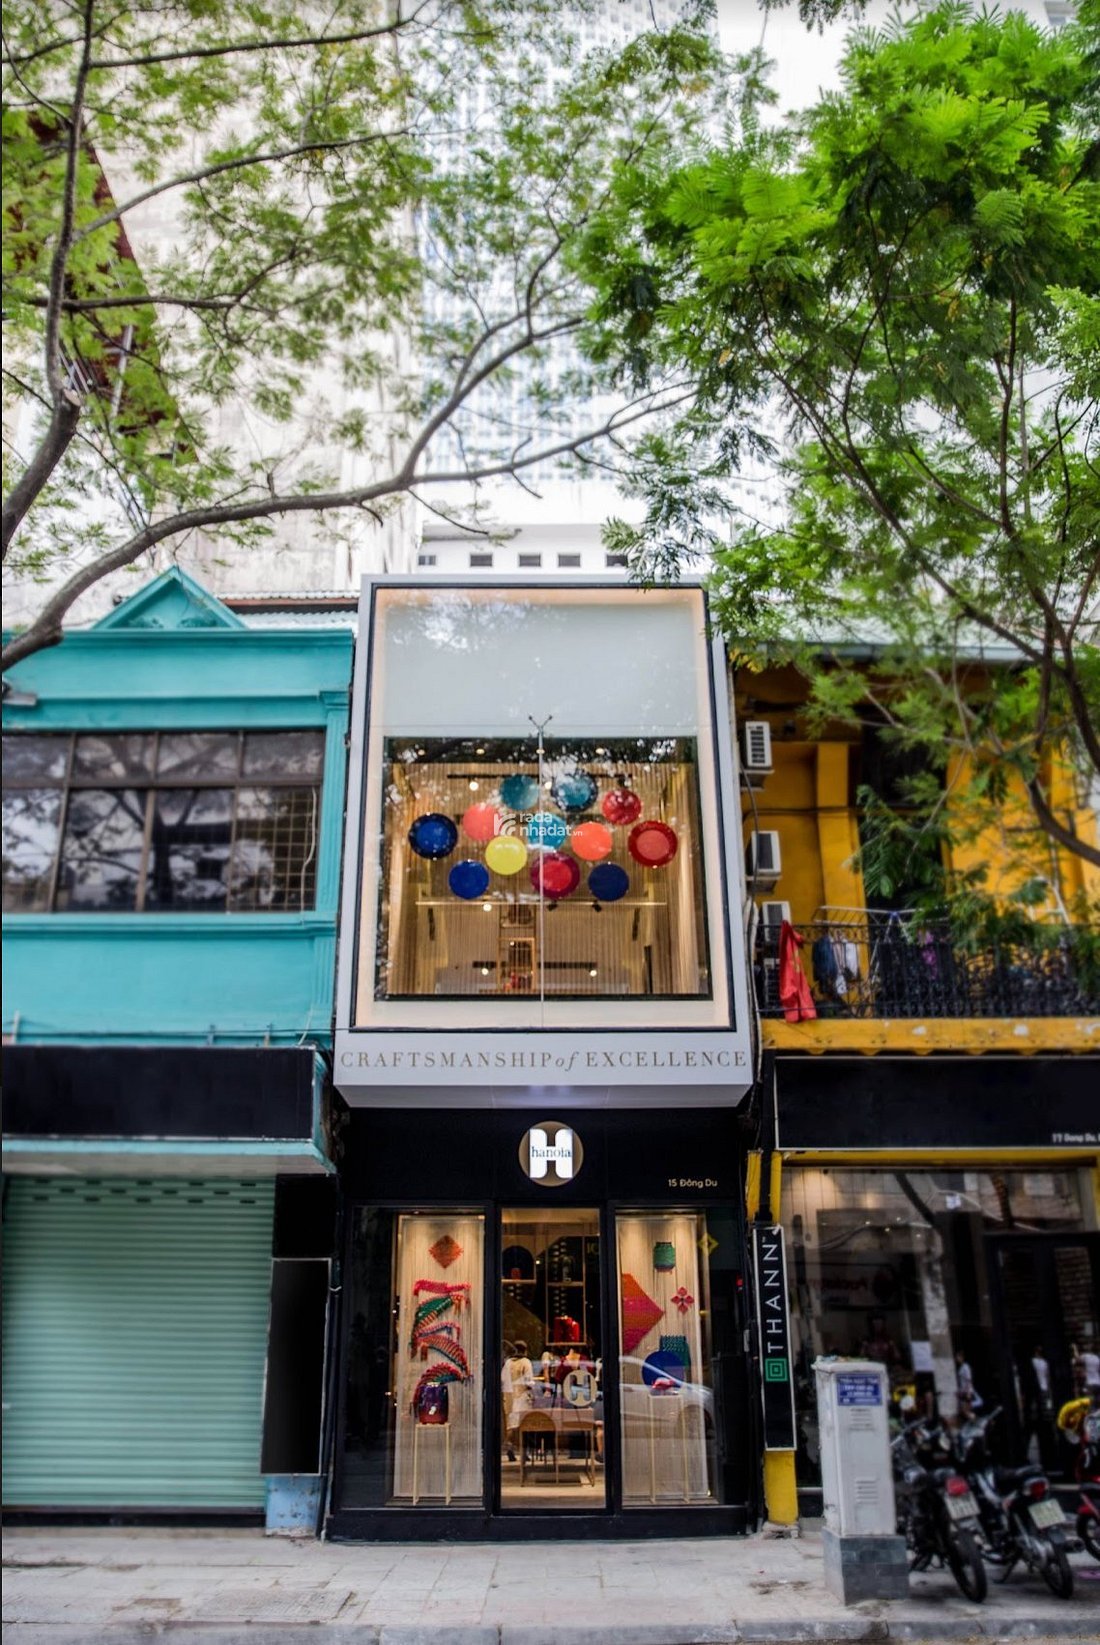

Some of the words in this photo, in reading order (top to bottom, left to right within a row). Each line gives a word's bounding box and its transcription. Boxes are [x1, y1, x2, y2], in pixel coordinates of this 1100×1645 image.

[340, 1051, 551, 1068] CRAFTSMANSHIP
[555, 1051, 579, 1072] of
[586, 1051, 747, 1068] EXCELLENCE
[668, 1178, 678, 1188] 15
[704, 1178, 718, 1187] Du
[762, 1244, 784, 1354] THANN
